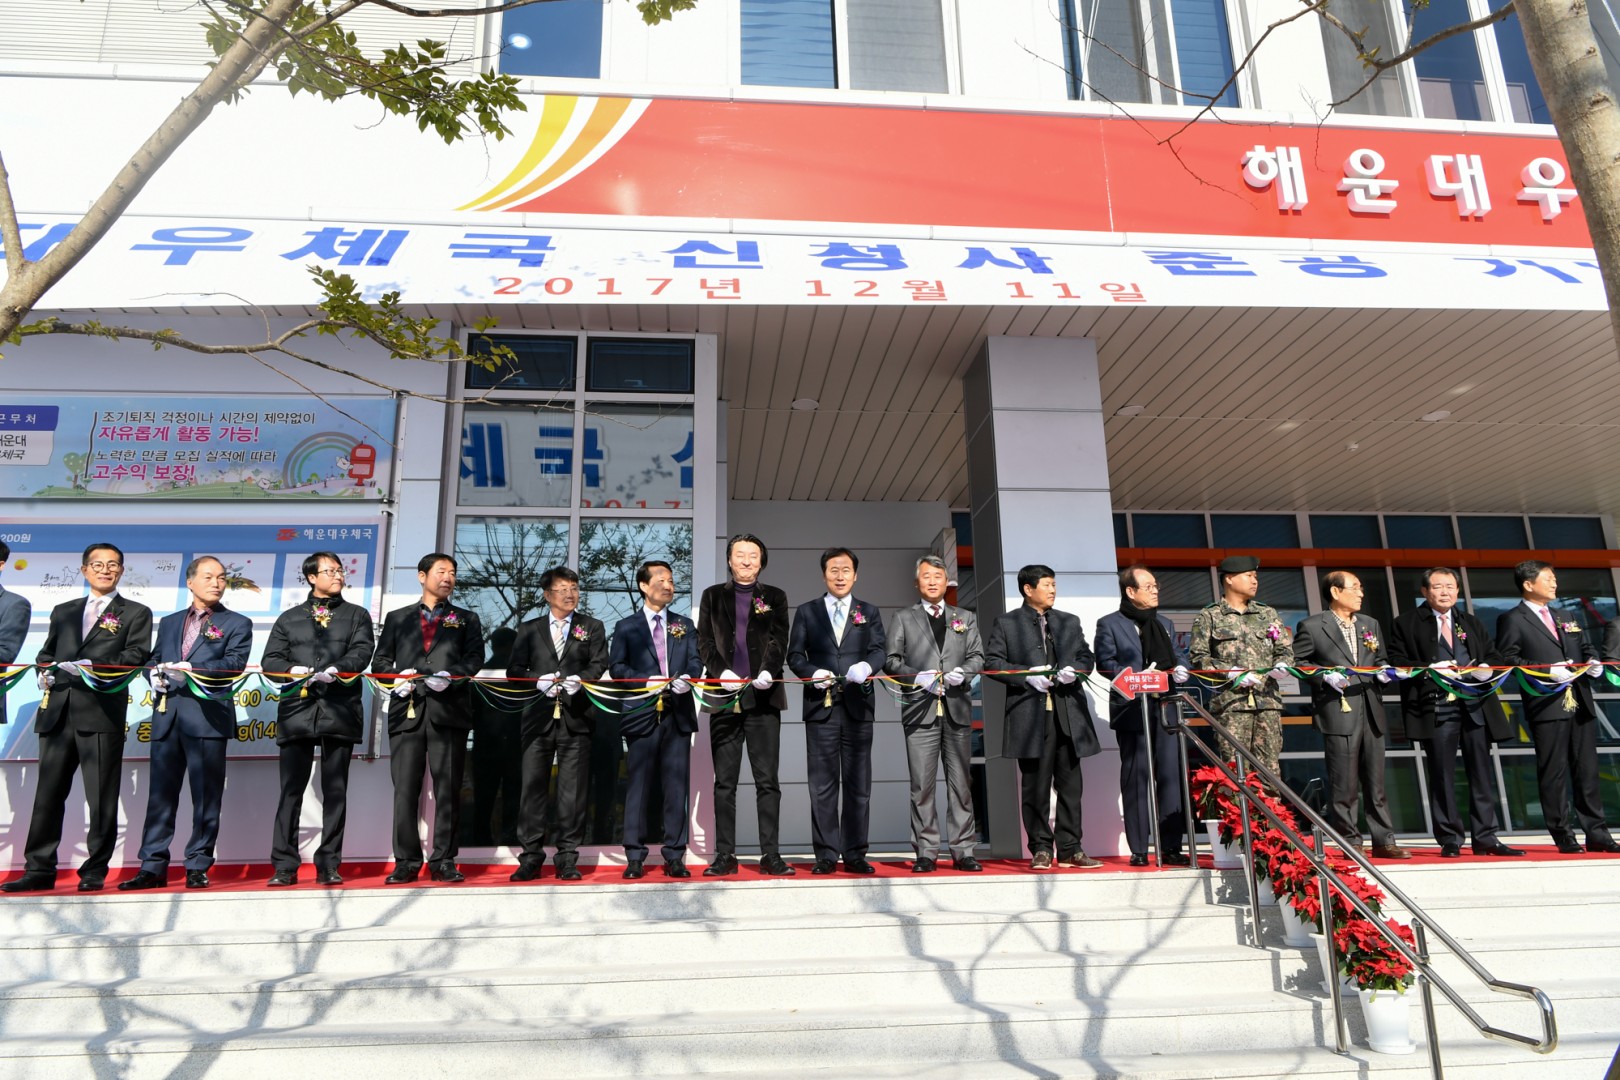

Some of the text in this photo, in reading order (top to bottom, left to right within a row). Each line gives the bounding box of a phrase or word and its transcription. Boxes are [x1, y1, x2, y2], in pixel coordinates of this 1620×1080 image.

[1241, 144, 1578, 219] 해운대우
[1141, 250, 1388, 279] 준공
[493, 277, 1147, 302] 2017년 12월 11일
[101, 411, 315, 425] 조기퇴직 걱정이나 시간의 제약없이
[98, 425, 259, 443] 자유롭게 활동 가능!
[94, 450, 277, 463] 노력한 만큼 모집 실적에 따라
[92, 464, 195, 482] 고수익 보장!
[303, 528, 373, 541] 해운대우체국
